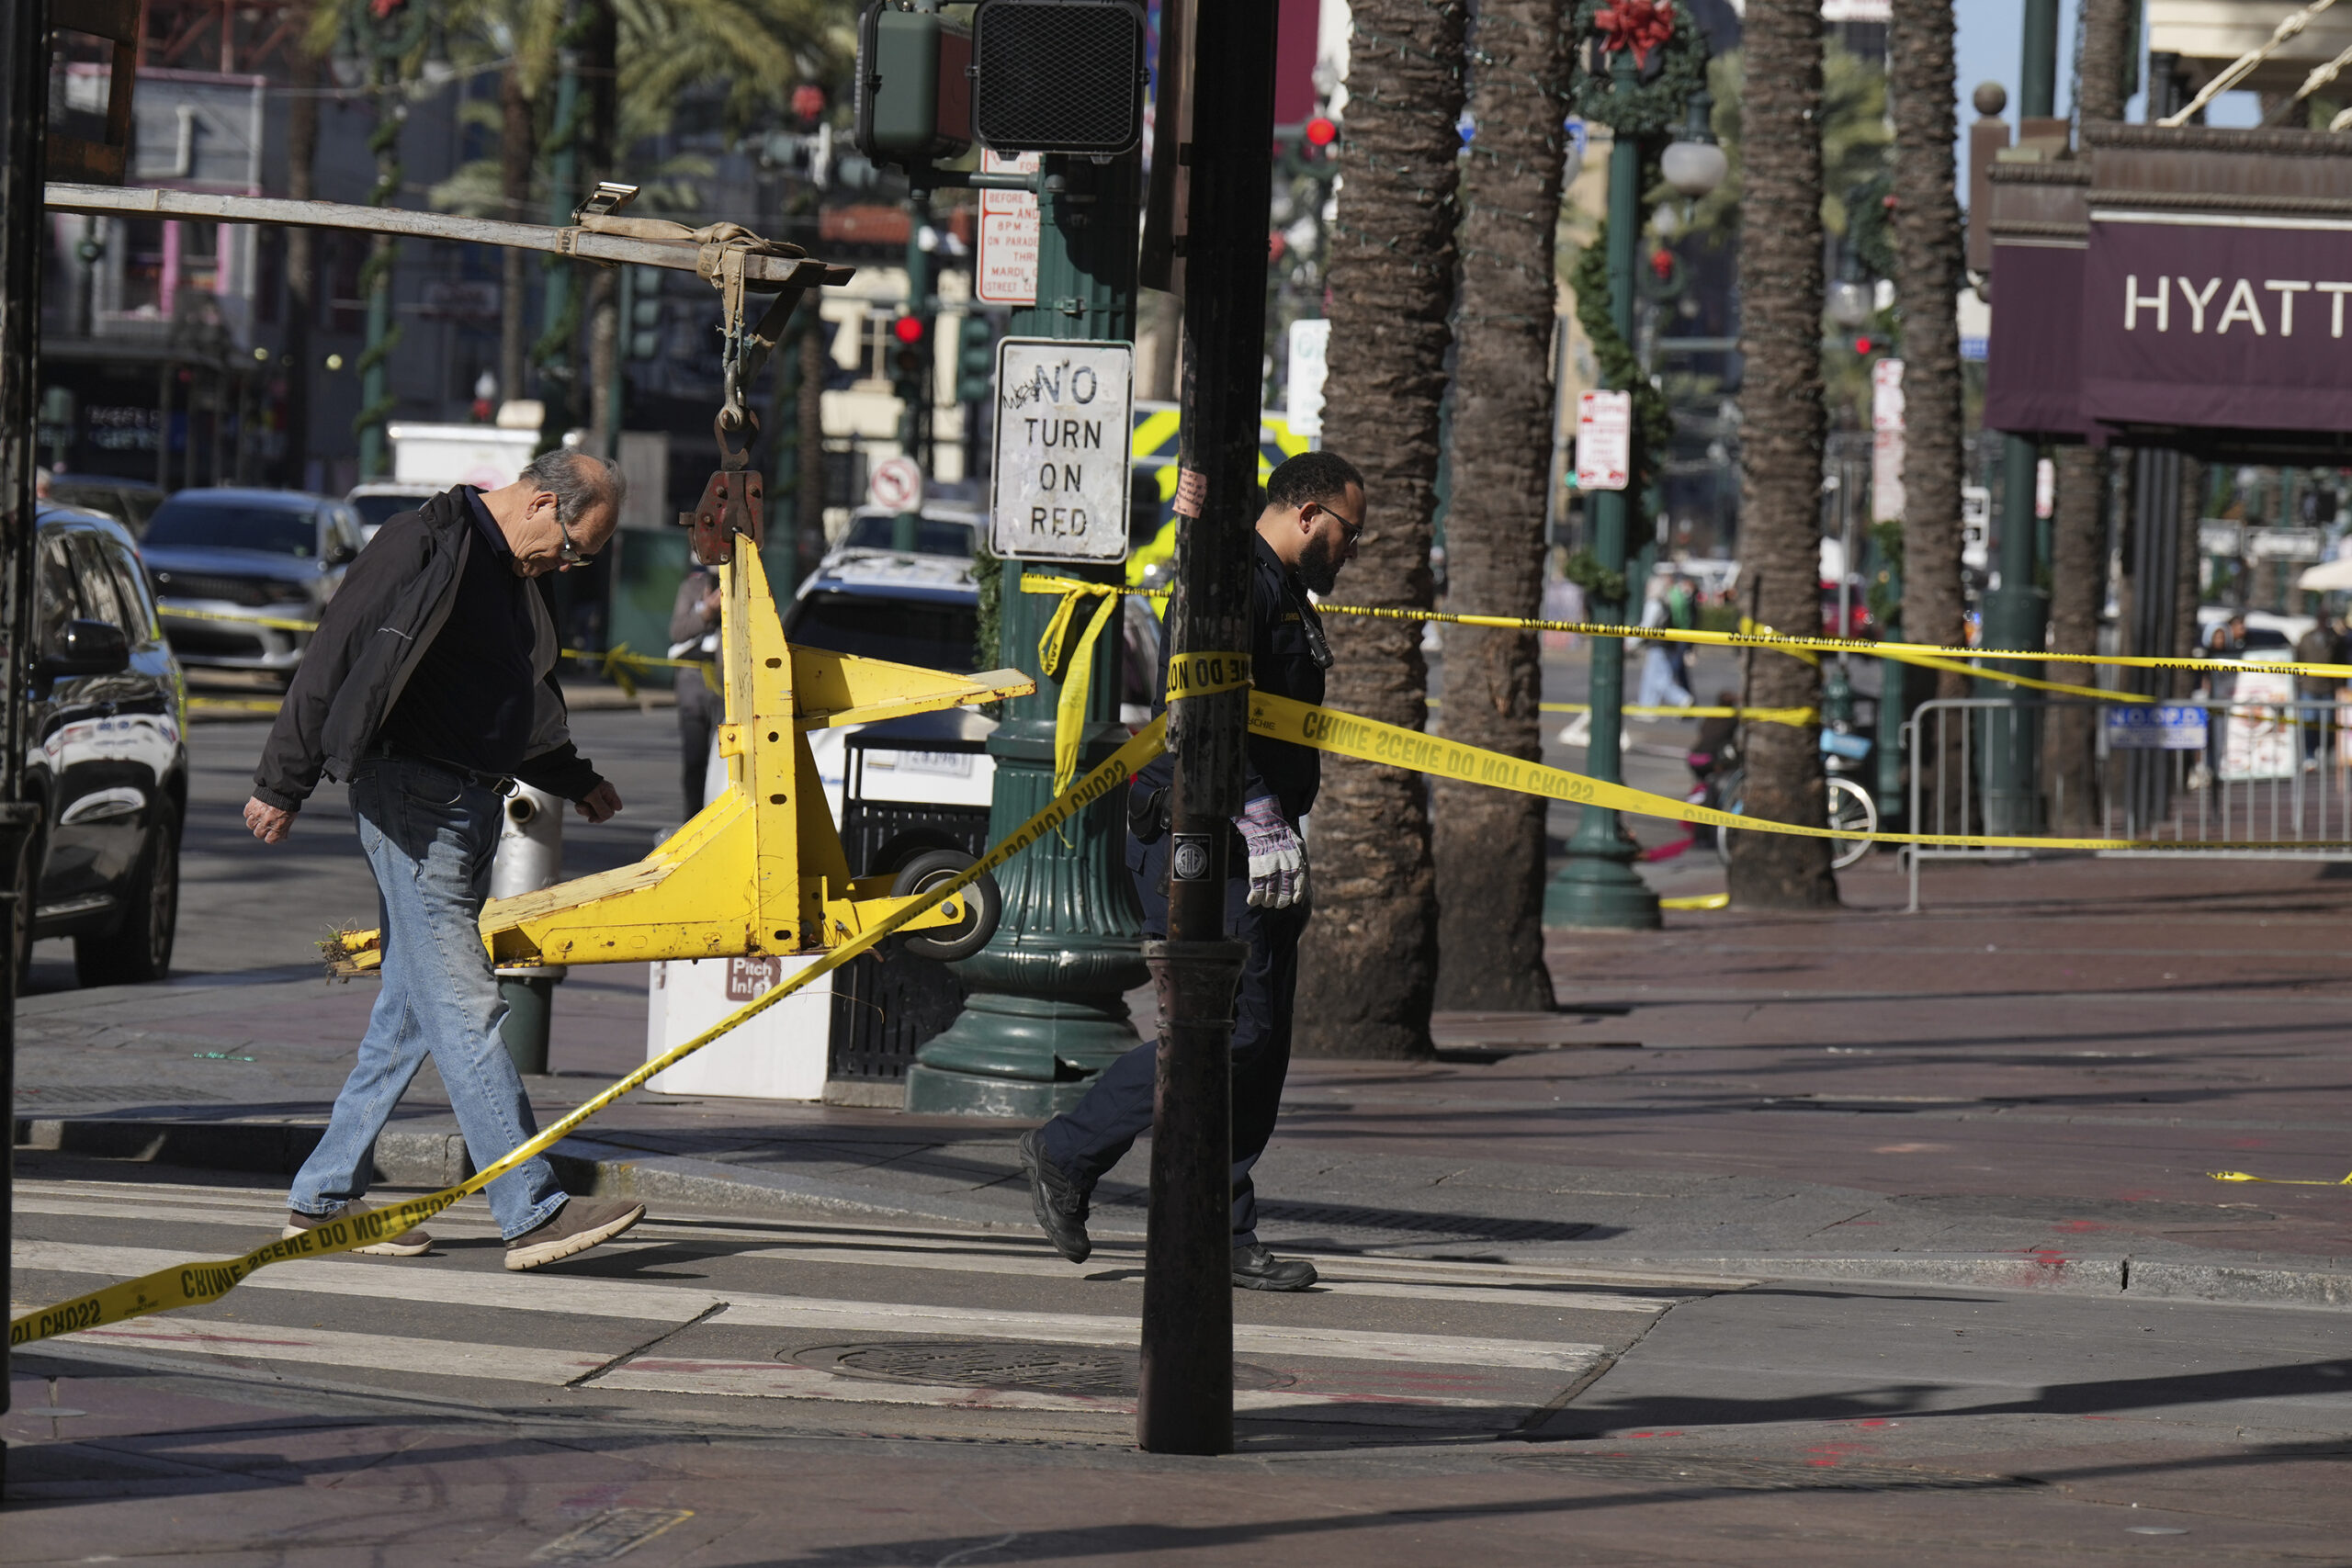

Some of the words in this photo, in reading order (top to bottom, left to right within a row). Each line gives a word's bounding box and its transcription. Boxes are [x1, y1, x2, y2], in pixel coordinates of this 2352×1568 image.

[989, 193, 1023, 204] BEFORE
[988, 235, 1000, 246] ON
[991, 266, 1025, 276] MARDI
[2124, 274, 2352, 339] HYATT
[1035, 364, 1097, 404] NO
[1024, 418, 1102, 449] TURN
[1040, 462, 1081, 492] ON
[1031, 506, 1087, 537] RED
[1195, 658, 1224, 686] DO
[733, 957, 773, 976] Pitch
[731, 976, 752, 994] In!
